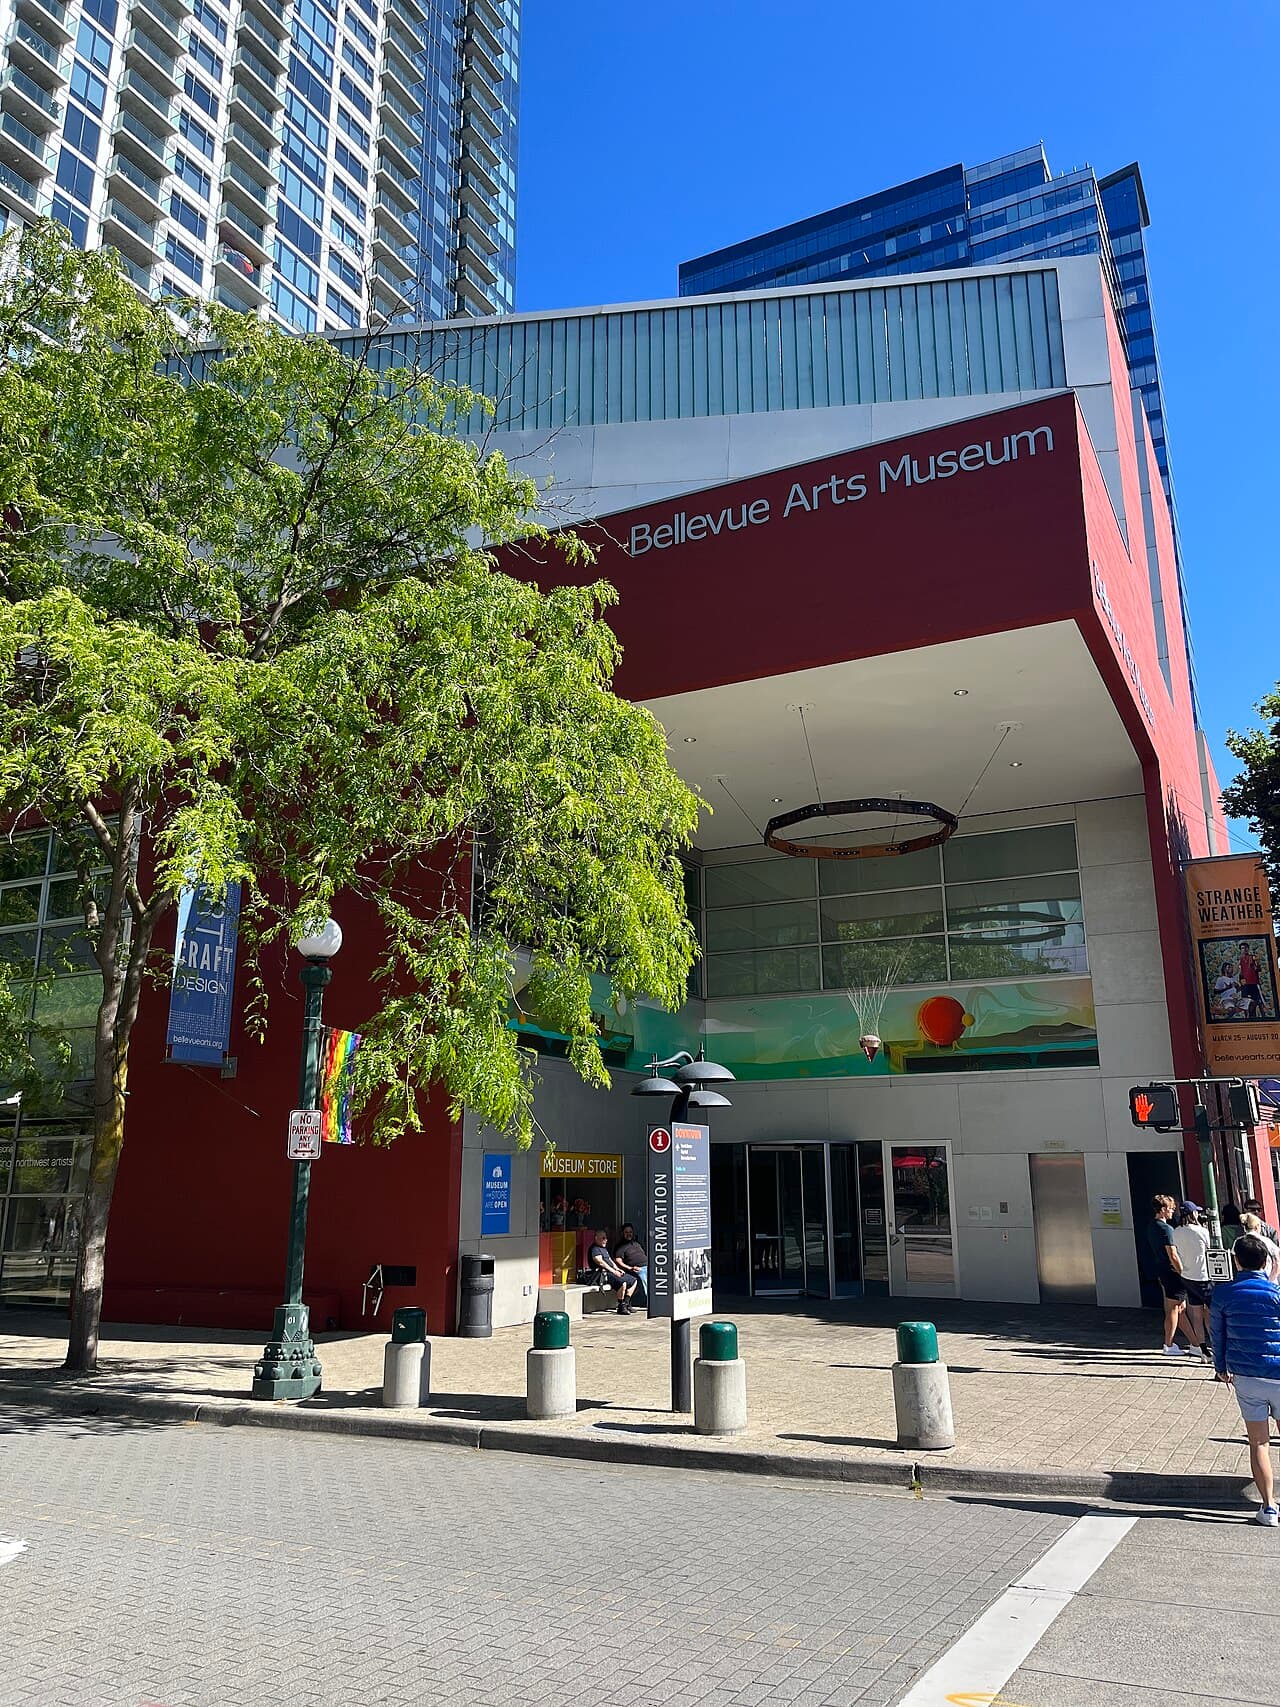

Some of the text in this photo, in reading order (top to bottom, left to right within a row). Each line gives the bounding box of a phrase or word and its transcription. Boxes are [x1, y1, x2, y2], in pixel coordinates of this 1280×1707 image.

[630, 425, 1055, 556] Bellevue Arts Museum
[1197, 886, 1261, 906] STRANGE
[1198, 904, 1264, 922] WEATHER
[177, 975, 228, 995] DESIGN
[173, 1034, 223, 1050] bellevuearts.org
[1212, 1034, 1233, 1042] MARCH
[300, 1115, 311, 1124] NO
[292, 1125, 318, 1135] PARKING
[16, 1157, 49, 1167] northwest
[51, 1157, 73, 1167] artists
[543, 1158, 617, 1174] MUSEUM STORE
[486, 1181, 508, 1189] MUSEUM
[491, 1190, 508, 1200] STORE
[494, 1201, 508, 1209] OPEN
[654, 1172, 667, 1297] INFORMATION
